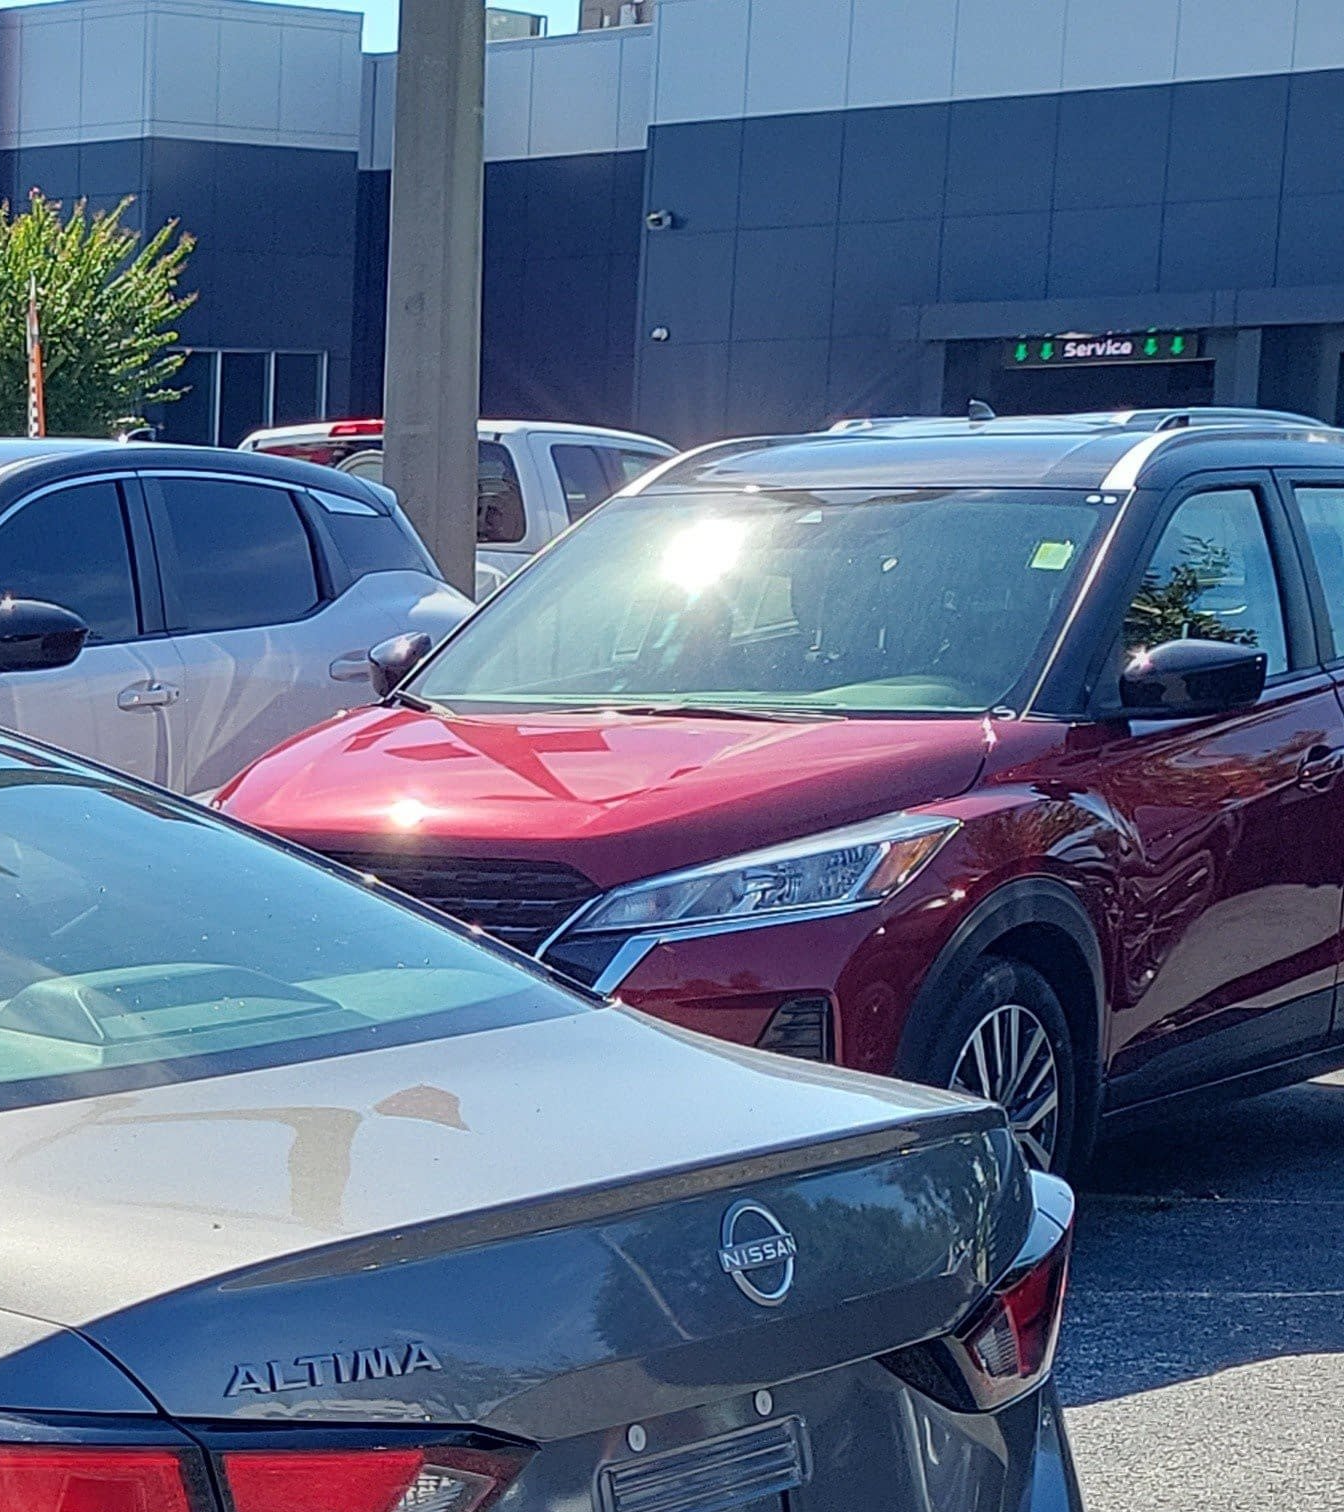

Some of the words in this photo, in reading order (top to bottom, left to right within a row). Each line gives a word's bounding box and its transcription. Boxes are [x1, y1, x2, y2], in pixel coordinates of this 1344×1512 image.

[1063, 339, 1133, 358] Service
[722, 1237, 797, 1269] NISSAN
[223, 1341, 443, 1398] ALTIMA
